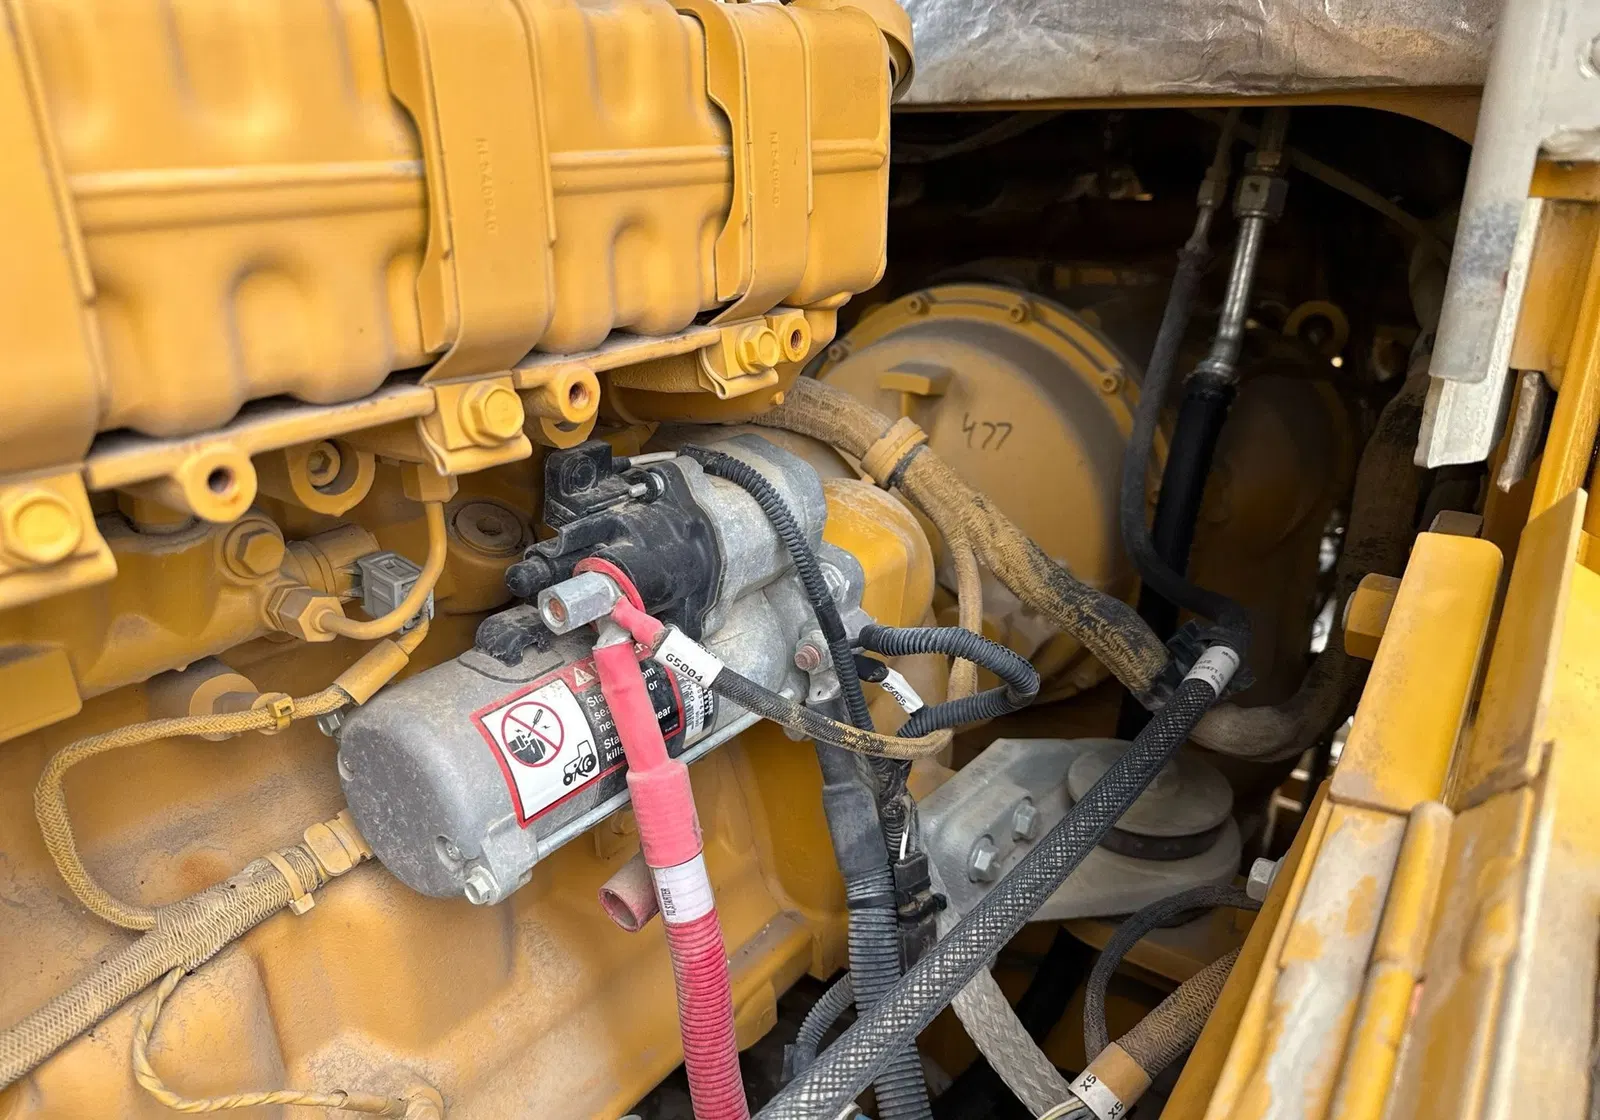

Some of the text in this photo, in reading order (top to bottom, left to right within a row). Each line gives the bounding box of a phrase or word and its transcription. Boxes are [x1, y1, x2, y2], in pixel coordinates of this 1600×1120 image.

[962, 411, 1013, 451] 477
[665, 652, 704, 682] G5004
[1080, 1074, 1097, 1092] X5
[1107, 1101, 1124, 1119] X5
